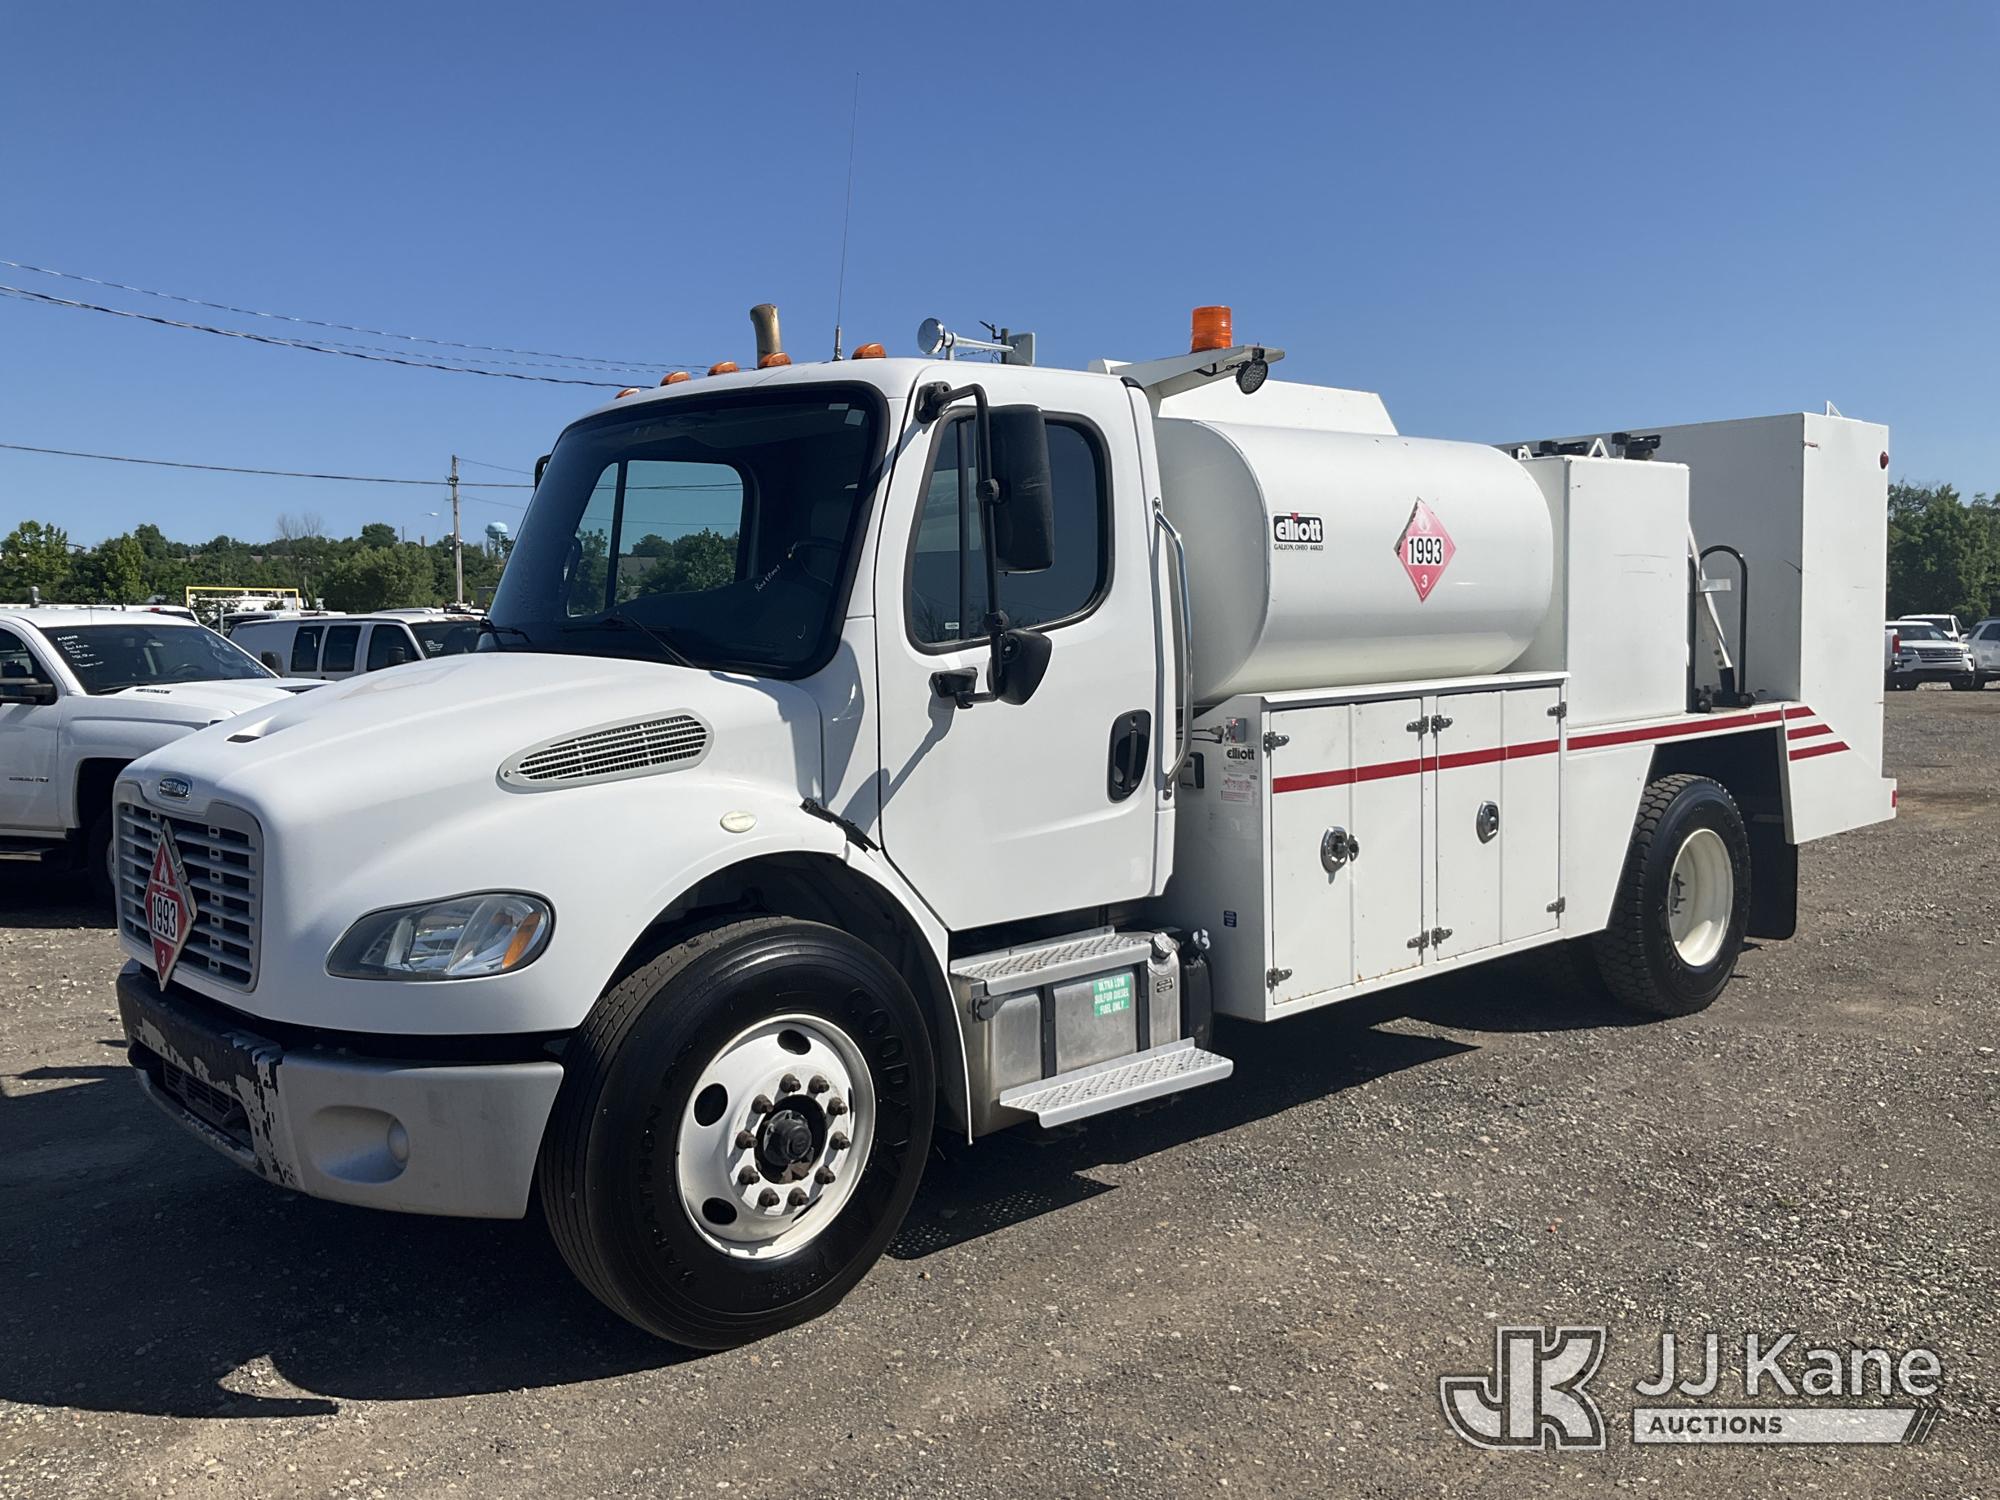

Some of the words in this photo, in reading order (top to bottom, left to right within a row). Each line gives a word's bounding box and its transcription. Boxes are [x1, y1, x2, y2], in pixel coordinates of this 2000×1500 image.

[1275, 516, 1321, 541] elliott
[1409, 538, 1442, 564] 1993
[1421, 574, 1428, 588] 3
[1227, 747, 1255, 760] elliott
[153, 895, 177, 939] 1993
[161, 950, 166, 968] 3
